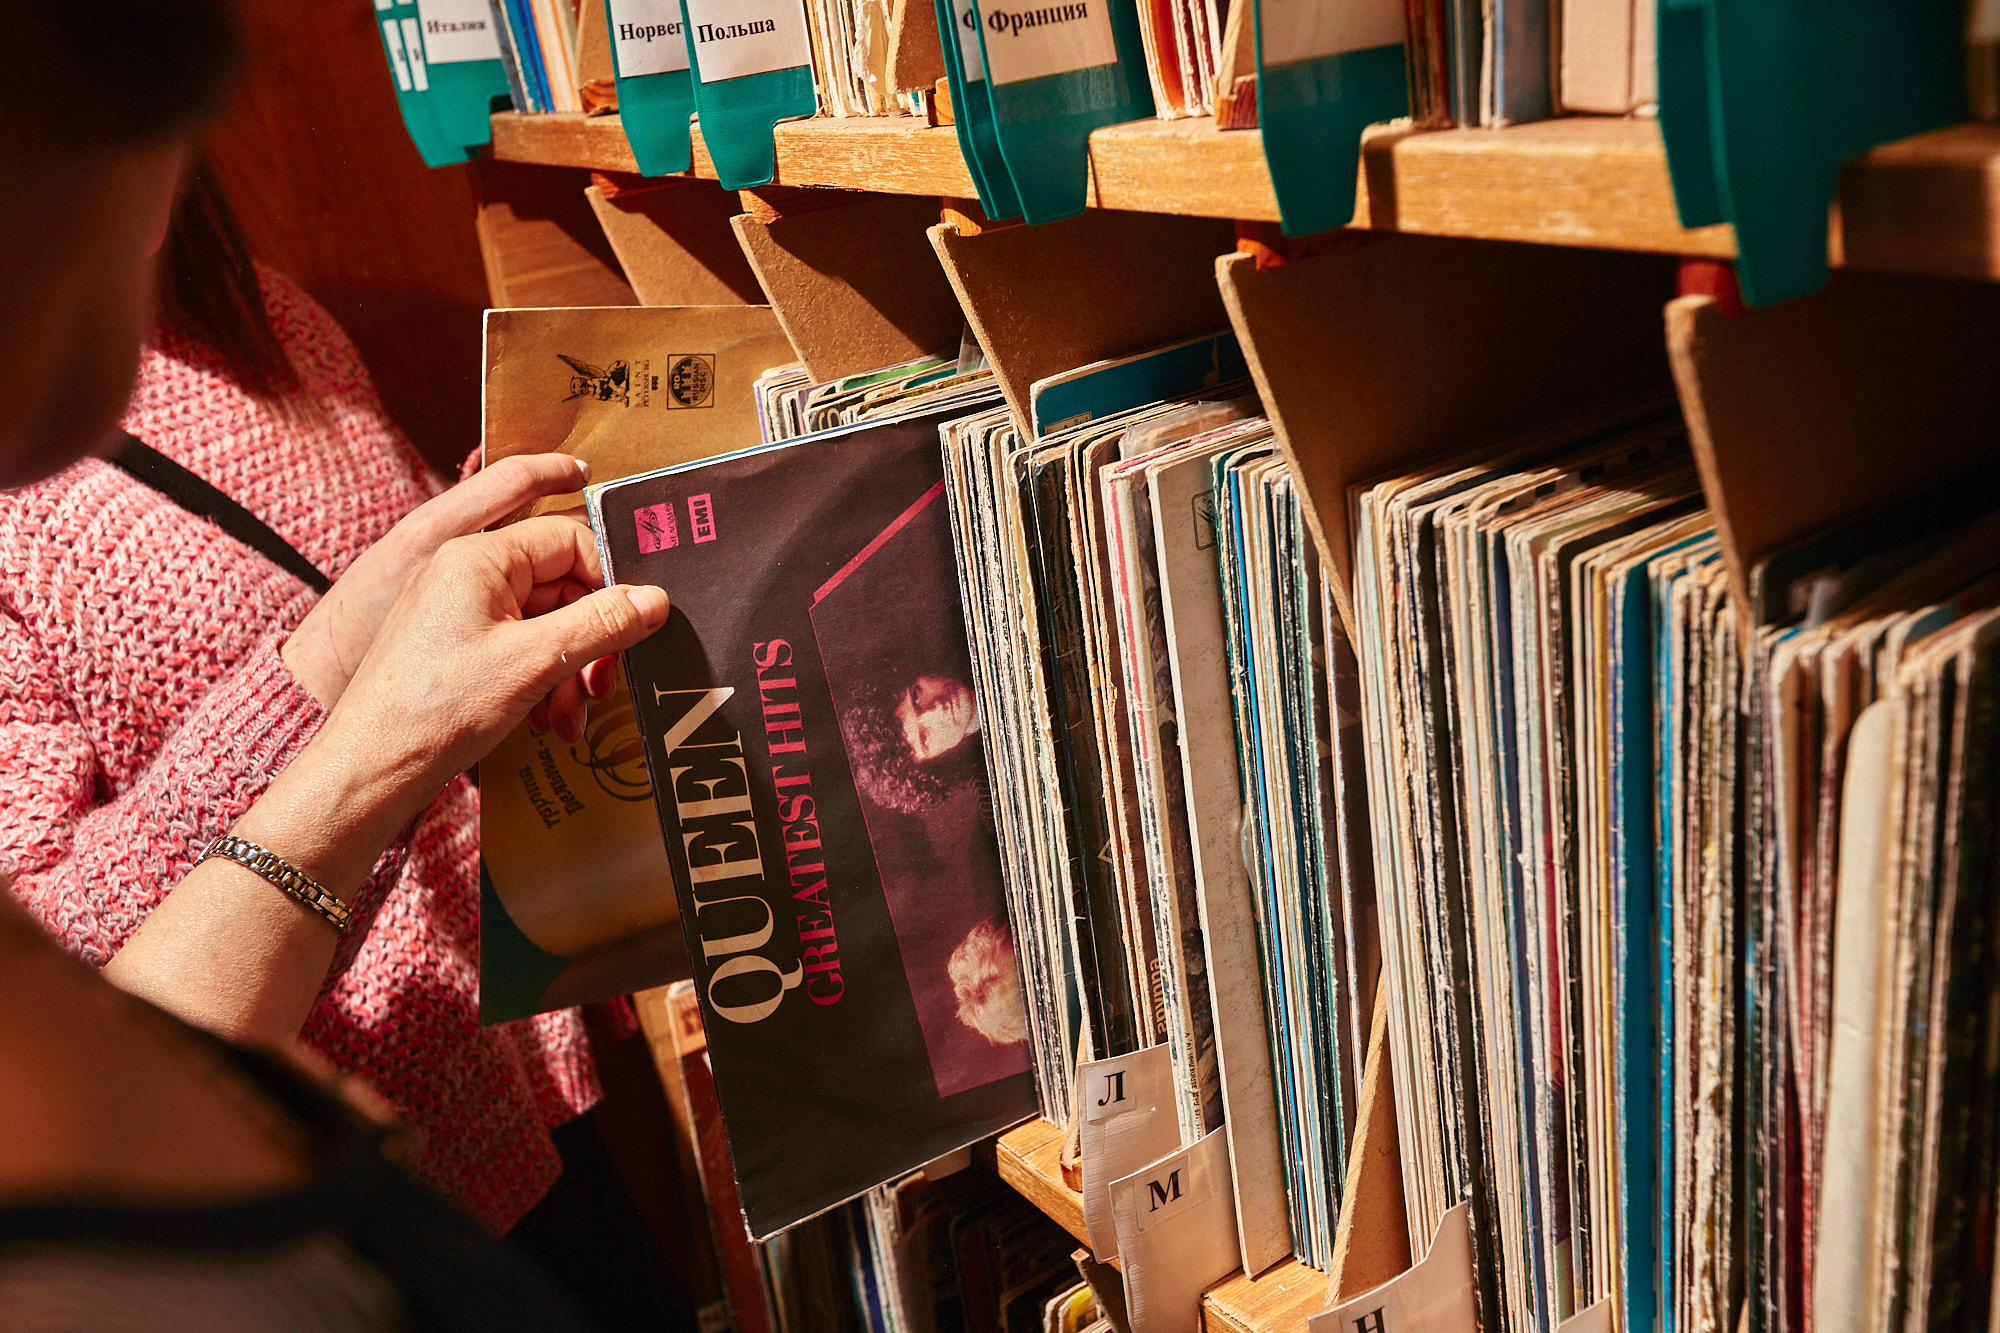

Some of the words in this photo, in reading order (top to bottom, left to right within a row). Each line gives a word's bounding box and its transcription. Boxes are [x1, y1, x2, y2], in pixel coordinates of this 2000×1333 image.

[697, 18, 776, 43] Польша
[988, 2, 1088, 37] Франция
[673, 374, 681, 390] RD
[693, 499, 711, 538] EMI
[753, 638, 807, 759] HITS
[652, 681, 804, 1024] QUEEN
[773, 765, 844, 1007] GREATEST
[1098, 1070, 1126, 1107] Л
[1146, 1168, 1184, 1213] М
